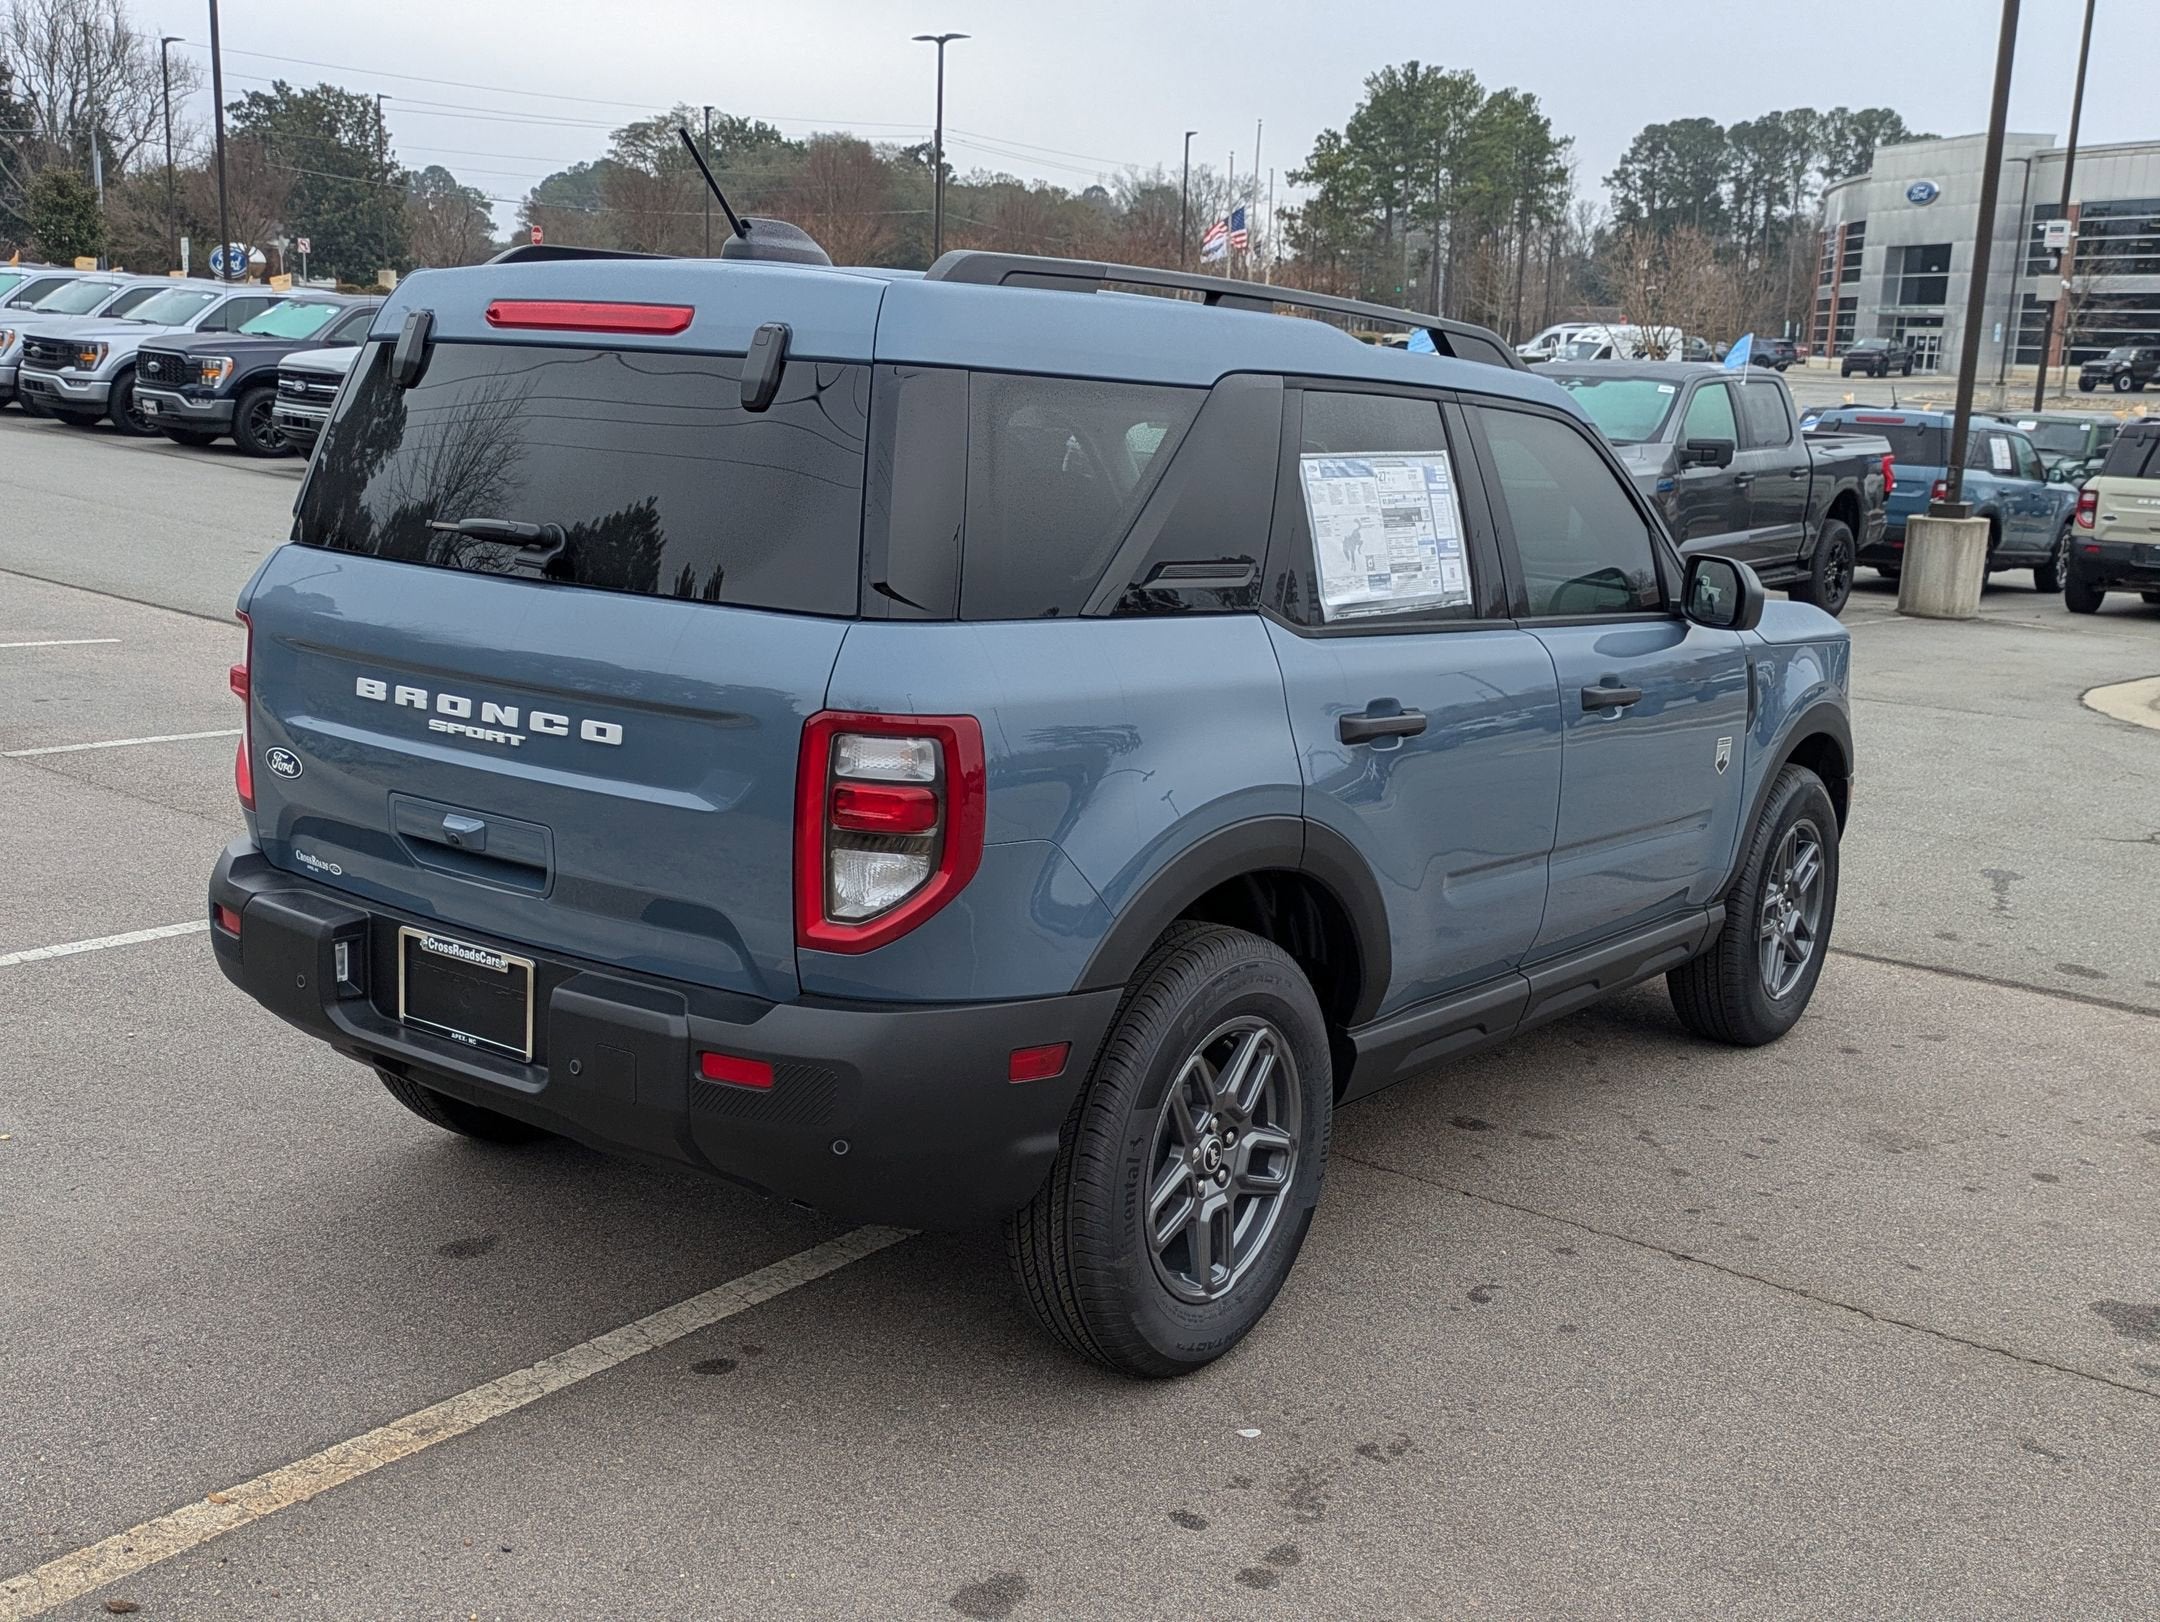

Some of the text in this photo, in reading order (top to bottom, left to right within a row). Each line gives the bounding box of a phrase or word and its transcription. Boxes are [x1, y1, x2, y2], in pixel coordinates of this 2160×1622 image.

[356, 677, 622, 745] BRONCO
[428, 719, 526, 746] SPORT
[271, 751, 294, 774] Ford
